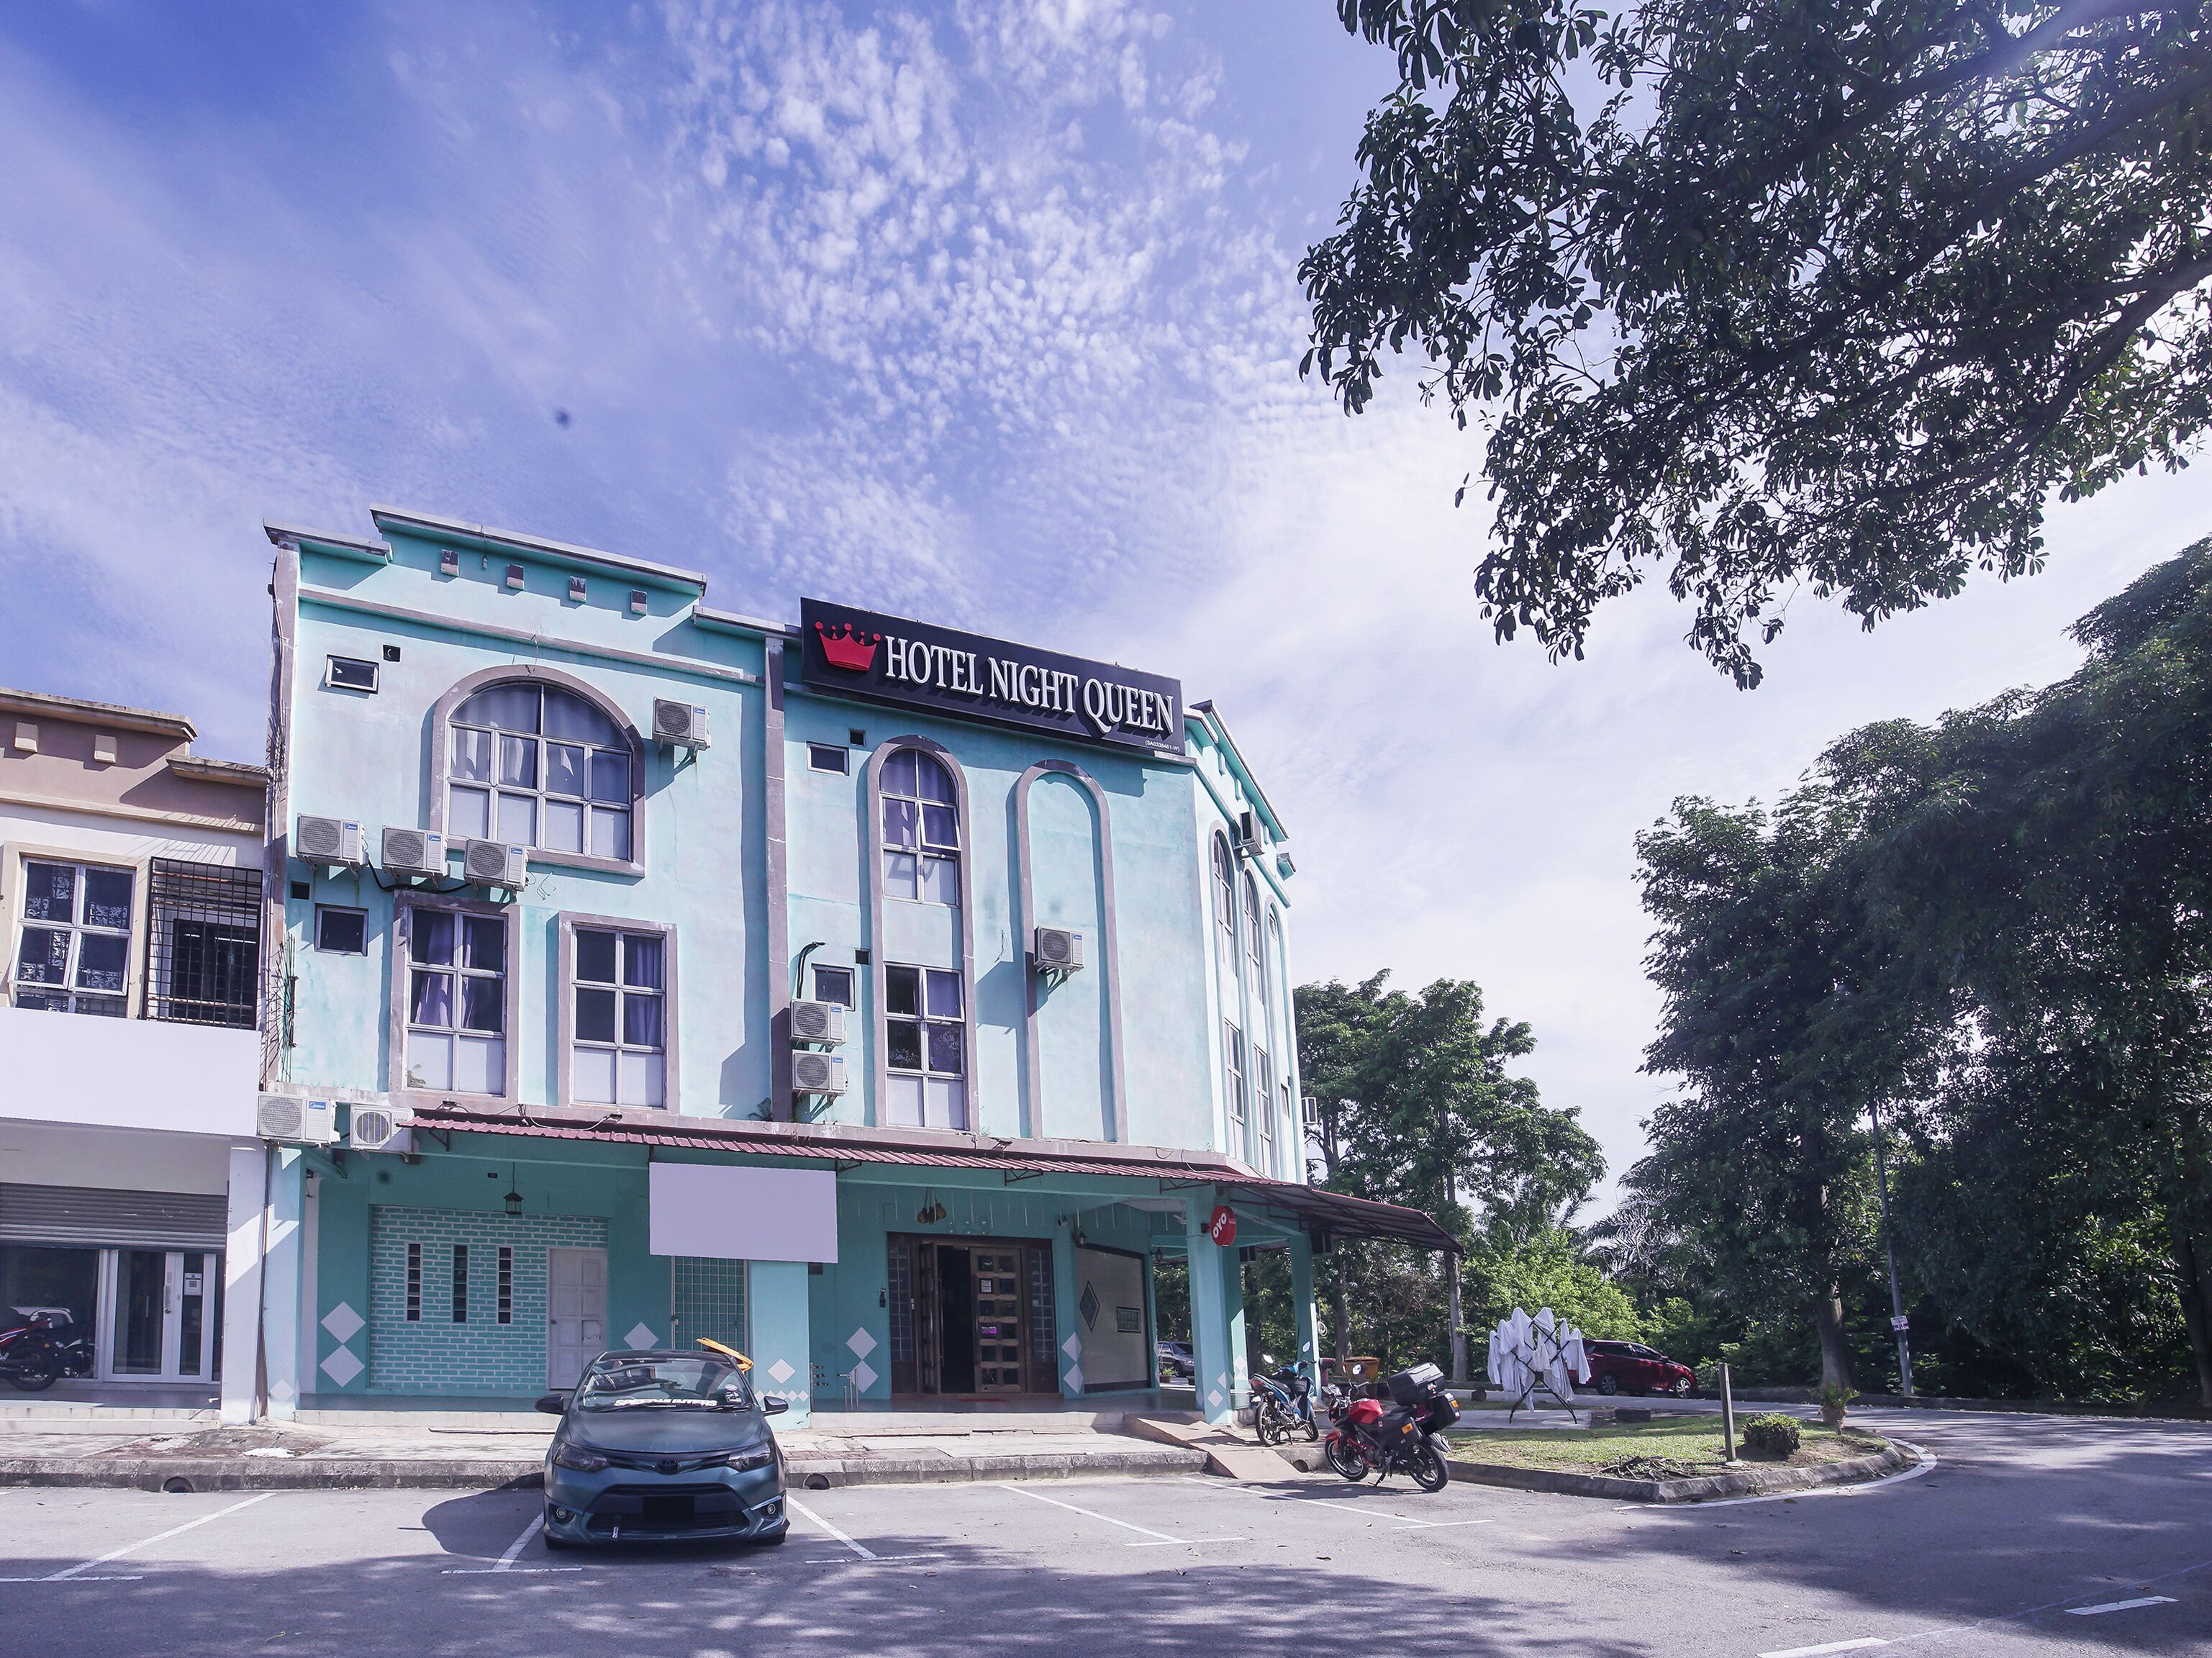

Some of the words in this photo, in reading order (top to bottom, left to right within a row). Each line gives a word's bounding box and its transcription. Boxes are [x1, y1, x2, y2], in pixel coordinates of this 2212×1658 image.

[885, 635, 983, 695] HOTEL
[987, 657, 1078, 713] NIGHT
[1083, 678, 1174, 734] QUEEN
[1213, 1213, 1227, 1238] OYO
